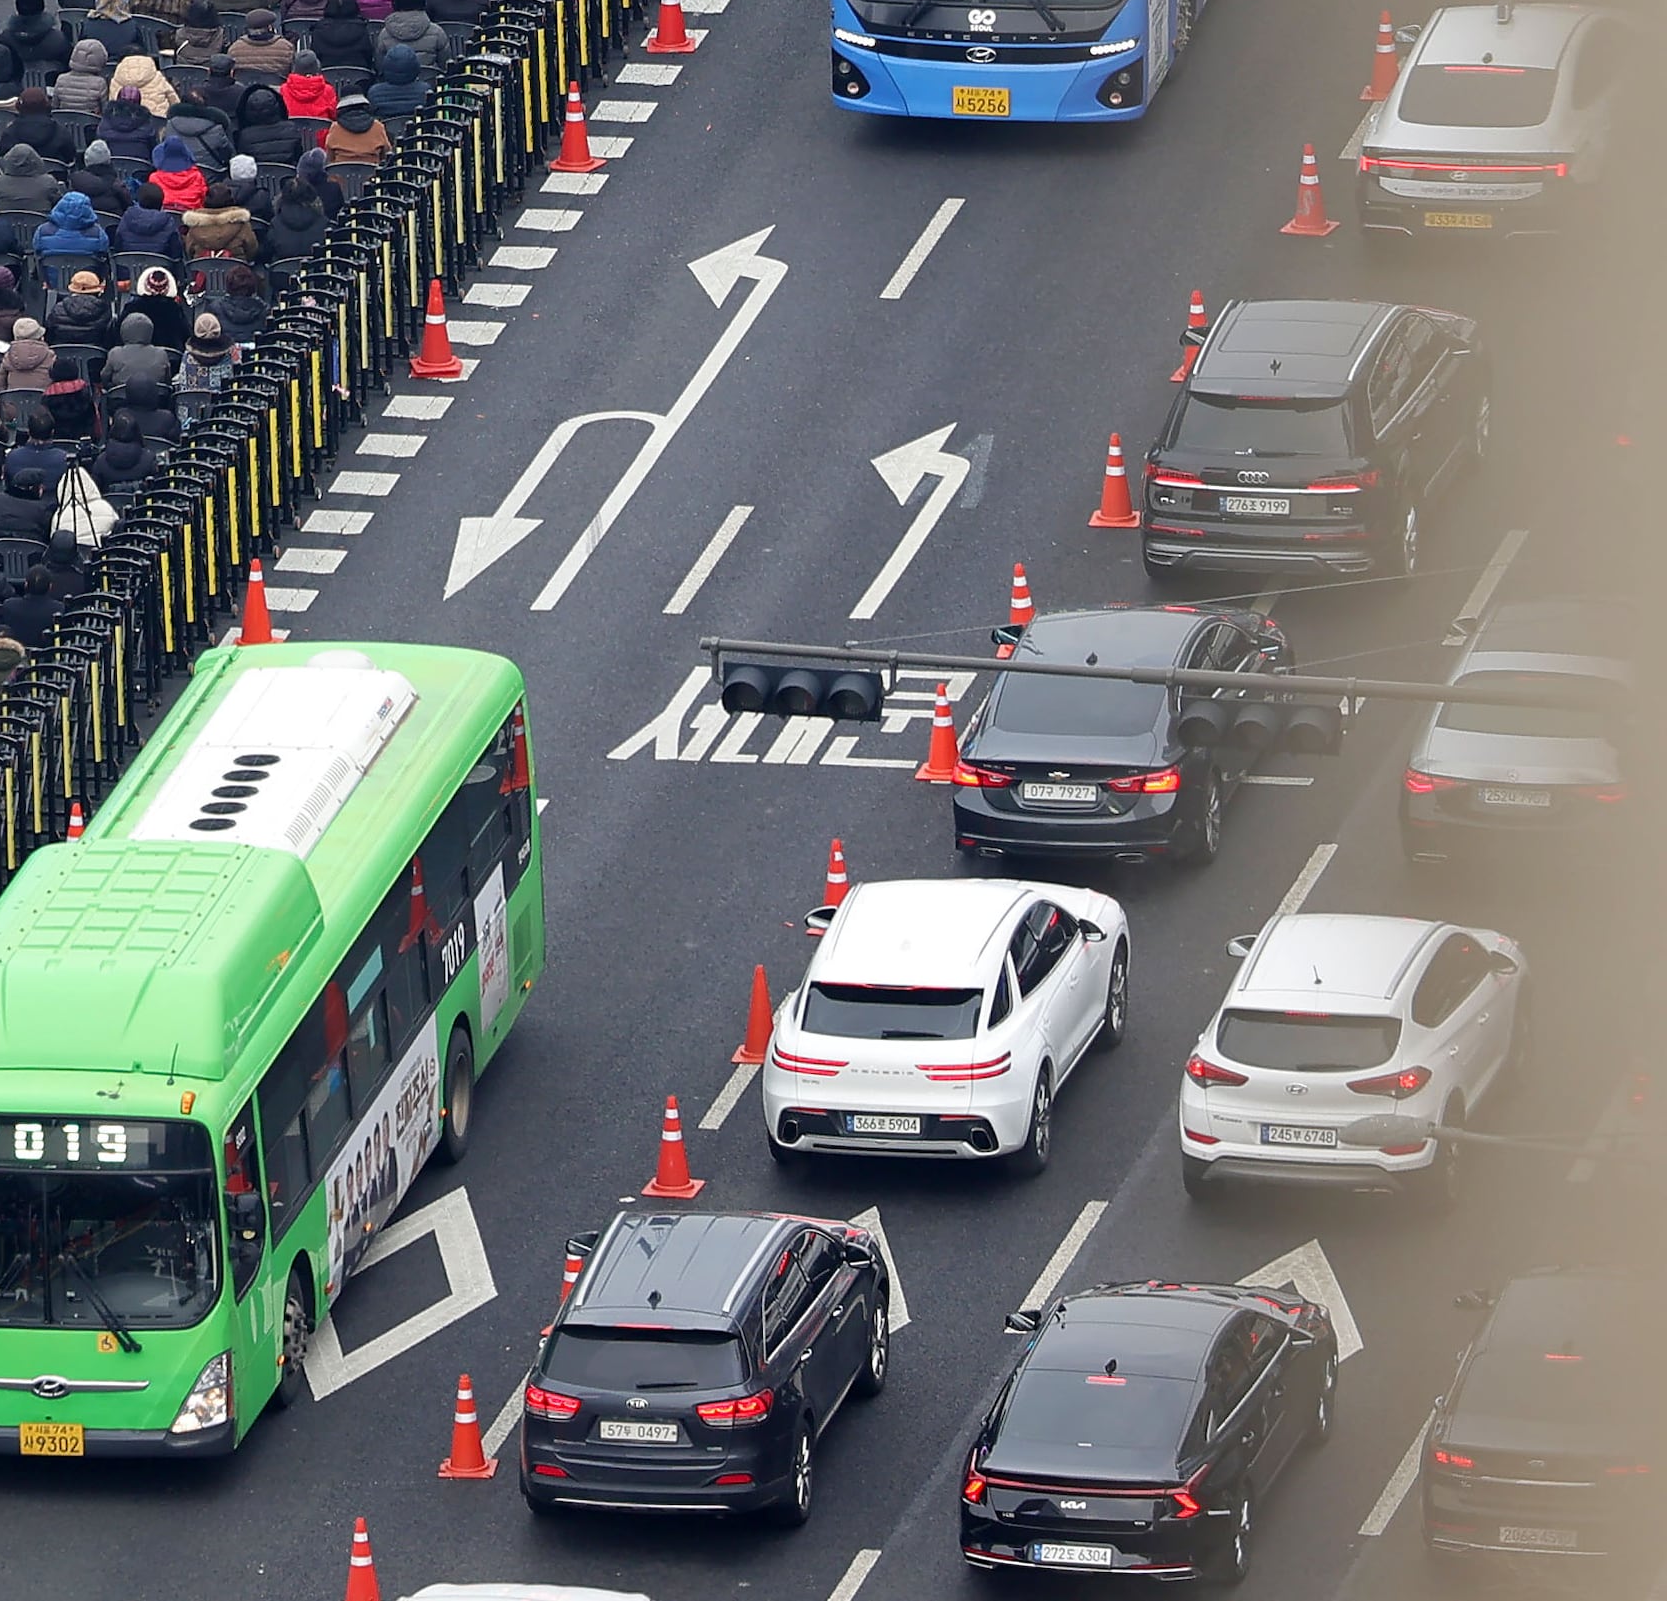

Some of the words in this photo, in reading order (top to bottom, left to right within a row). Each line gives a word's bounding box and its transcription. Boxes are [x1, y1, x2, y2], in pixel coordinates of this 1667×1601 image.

[968, 9, 996, 25] GO
[1259, 500, 1287, 512] 9199
[1030, 785, 1054, 798] 07구
[1059, 786, 1090, 799] 7927
[441, 922, 466, 984] 7019
[888, 1118, 917, 1130] 5904
[1303, 1129, 1334, 1143] 6748
[637, 1425, 670, 1439] 0497
[1078, 1548, 1107, 1562] 6304
